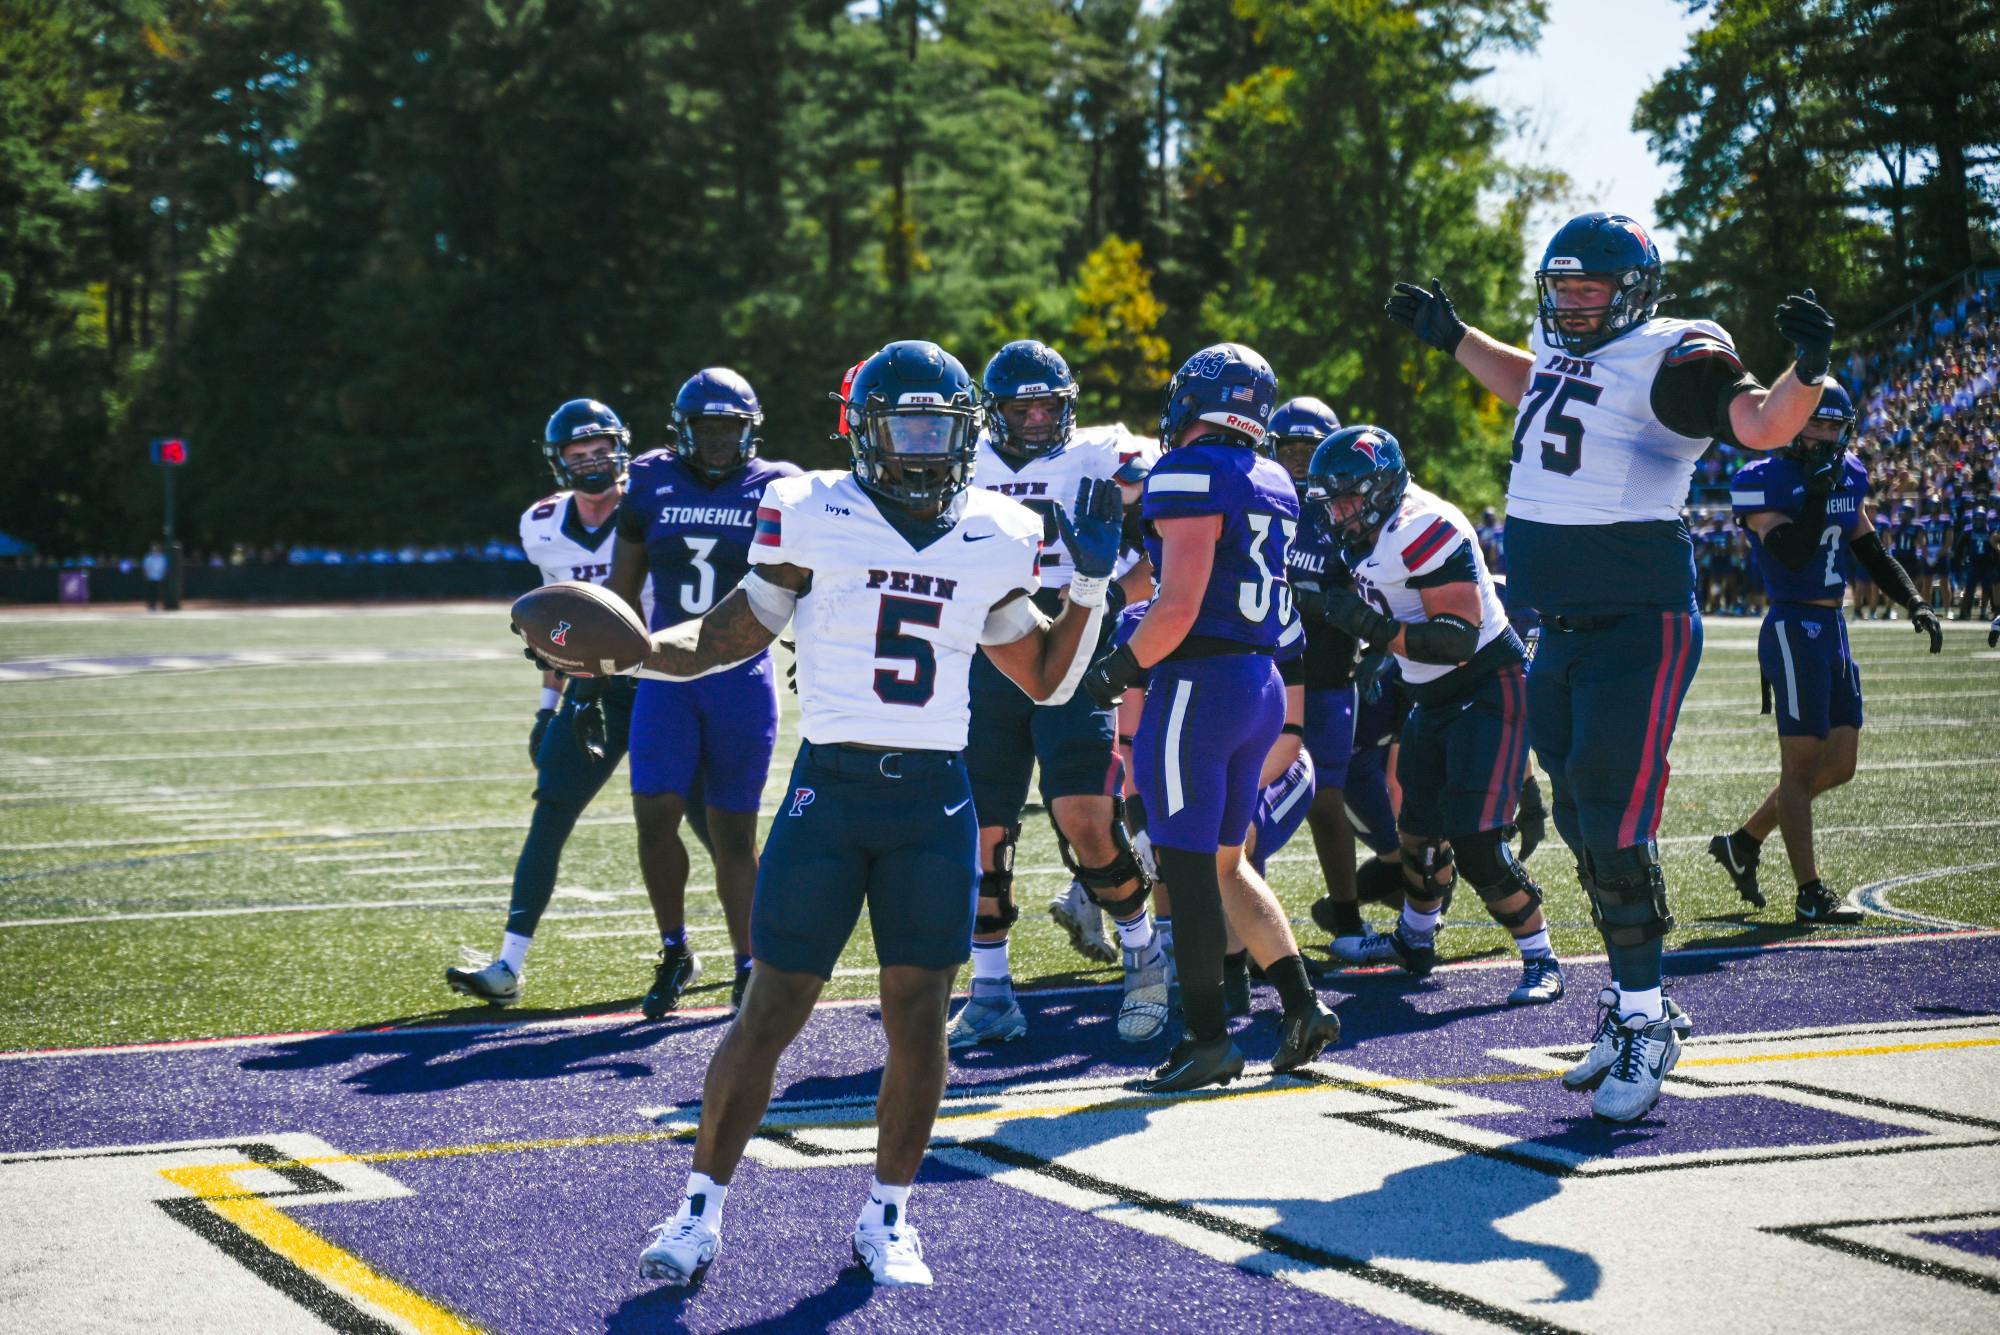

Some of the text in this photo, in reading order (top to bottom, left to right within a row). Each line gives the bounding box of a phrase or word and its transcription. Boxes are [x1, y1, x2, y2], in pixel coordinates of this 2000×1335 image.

[1544, 355, 1595, 378] PENN
[1226, 415, 1264, 438] Riddell
[1511, 372, 1604, 477] 75
[659, 506, 753, 527] STONEHILL
[824, 503, 842, 516] Ivy
[1238, 513, 1298, 626] 33
[1820, 525, 1843, 587] 2
[571, 563, 612, 579] PEN
[680, 536, 718, 614] 3
[866, 569, 958, 600] PENN
[873, 593, 944, 708] 5
[789, 788, 815, 816] P
